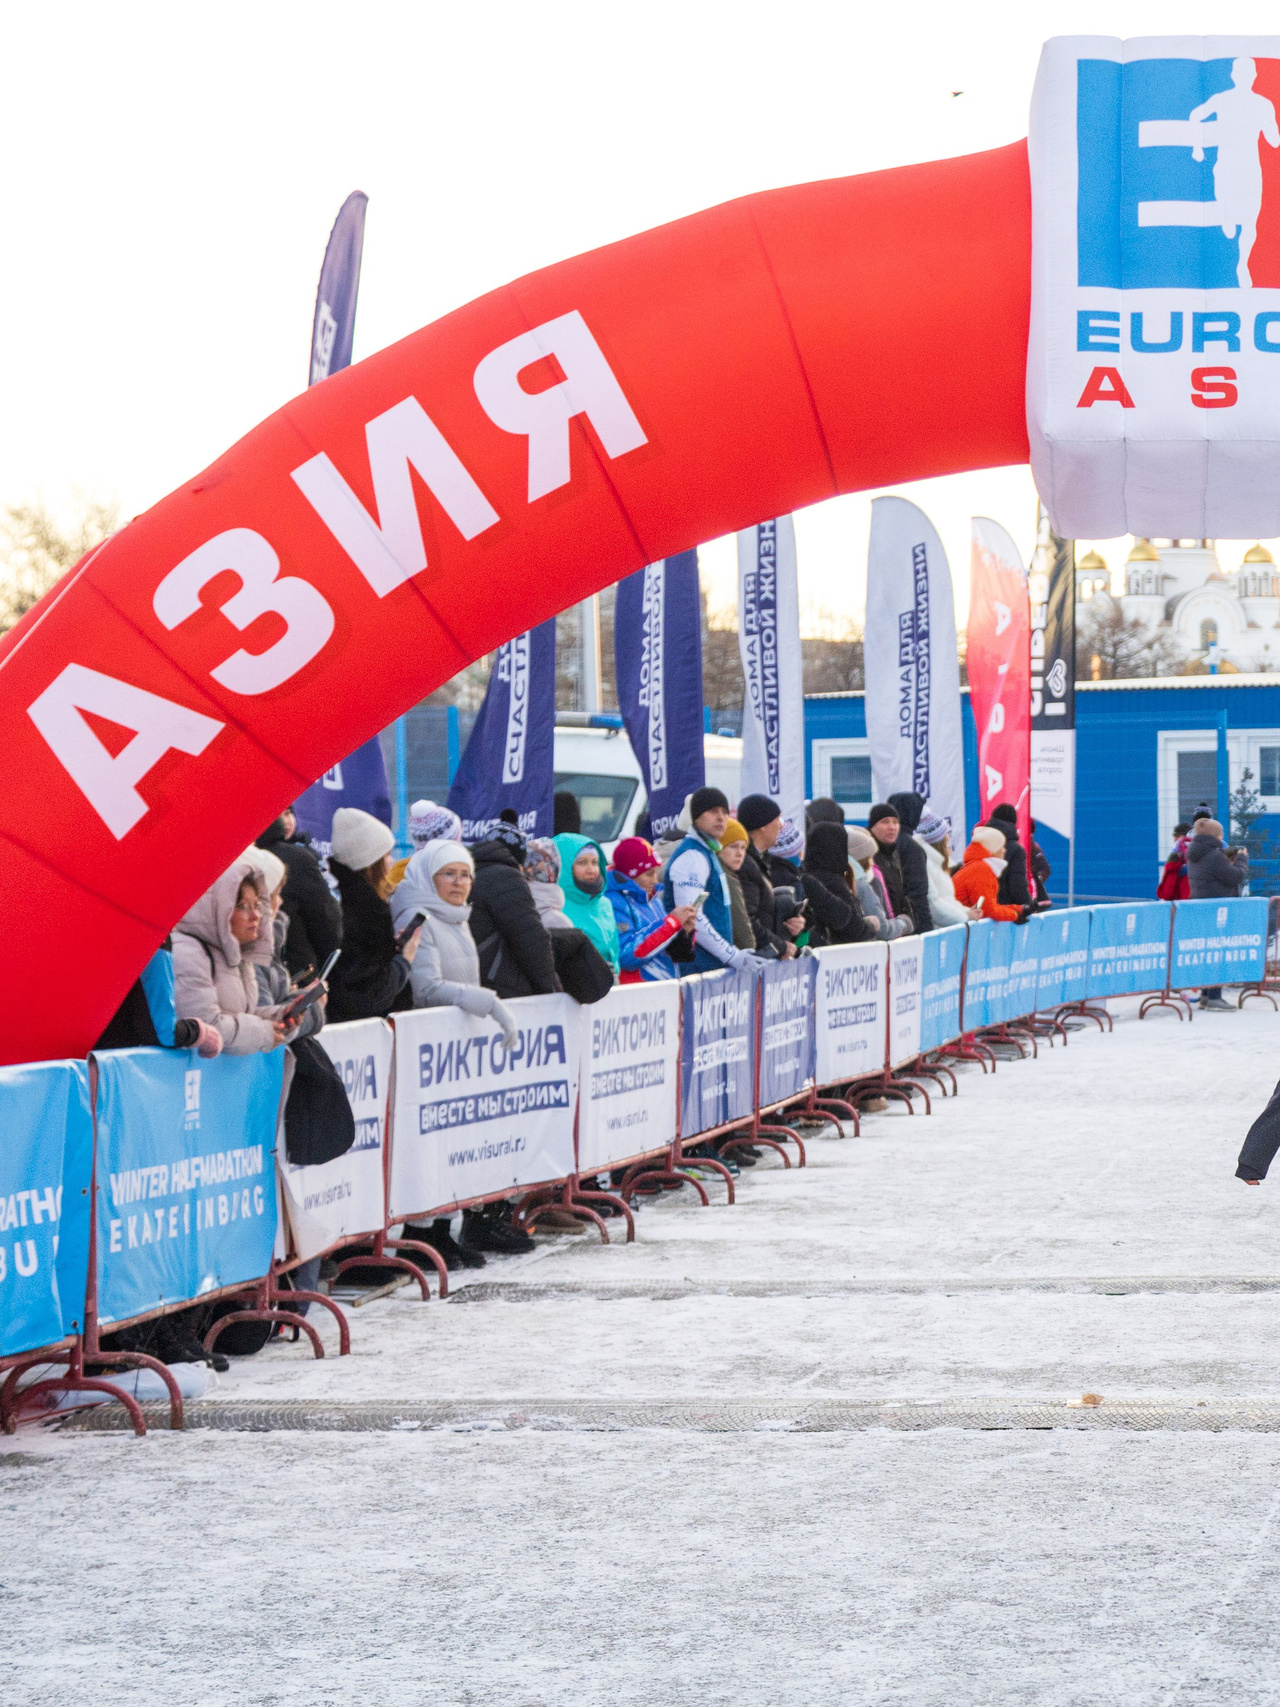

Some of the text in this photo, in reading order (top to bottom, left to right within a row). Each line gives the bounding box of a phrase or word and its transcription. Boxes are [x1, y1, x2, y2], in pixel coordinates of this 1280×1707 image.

[27, 309, 649, 841] АЗИЯ
[745, 574, 761, 720] ДОМА ДЛЯ
[899, 611, 914, 738] ДОМА ДЛЯ
[914, 543, 930, 798] СЧАСТЛИВОЙ ЖИЗНИ
[758, 608, 779, 793] СЧАСТЛИВОЙ
[1178, 938, 1206, 951] WINTER
[419, 1024, 567, 1088] ВИКТОРИЯ
[593, 1009, 666, 1059] ВИКТОРИЯ
[421, 1083, 567, 1129] вместе мы строим
[110, 1165, 169, 1206] WINTER
